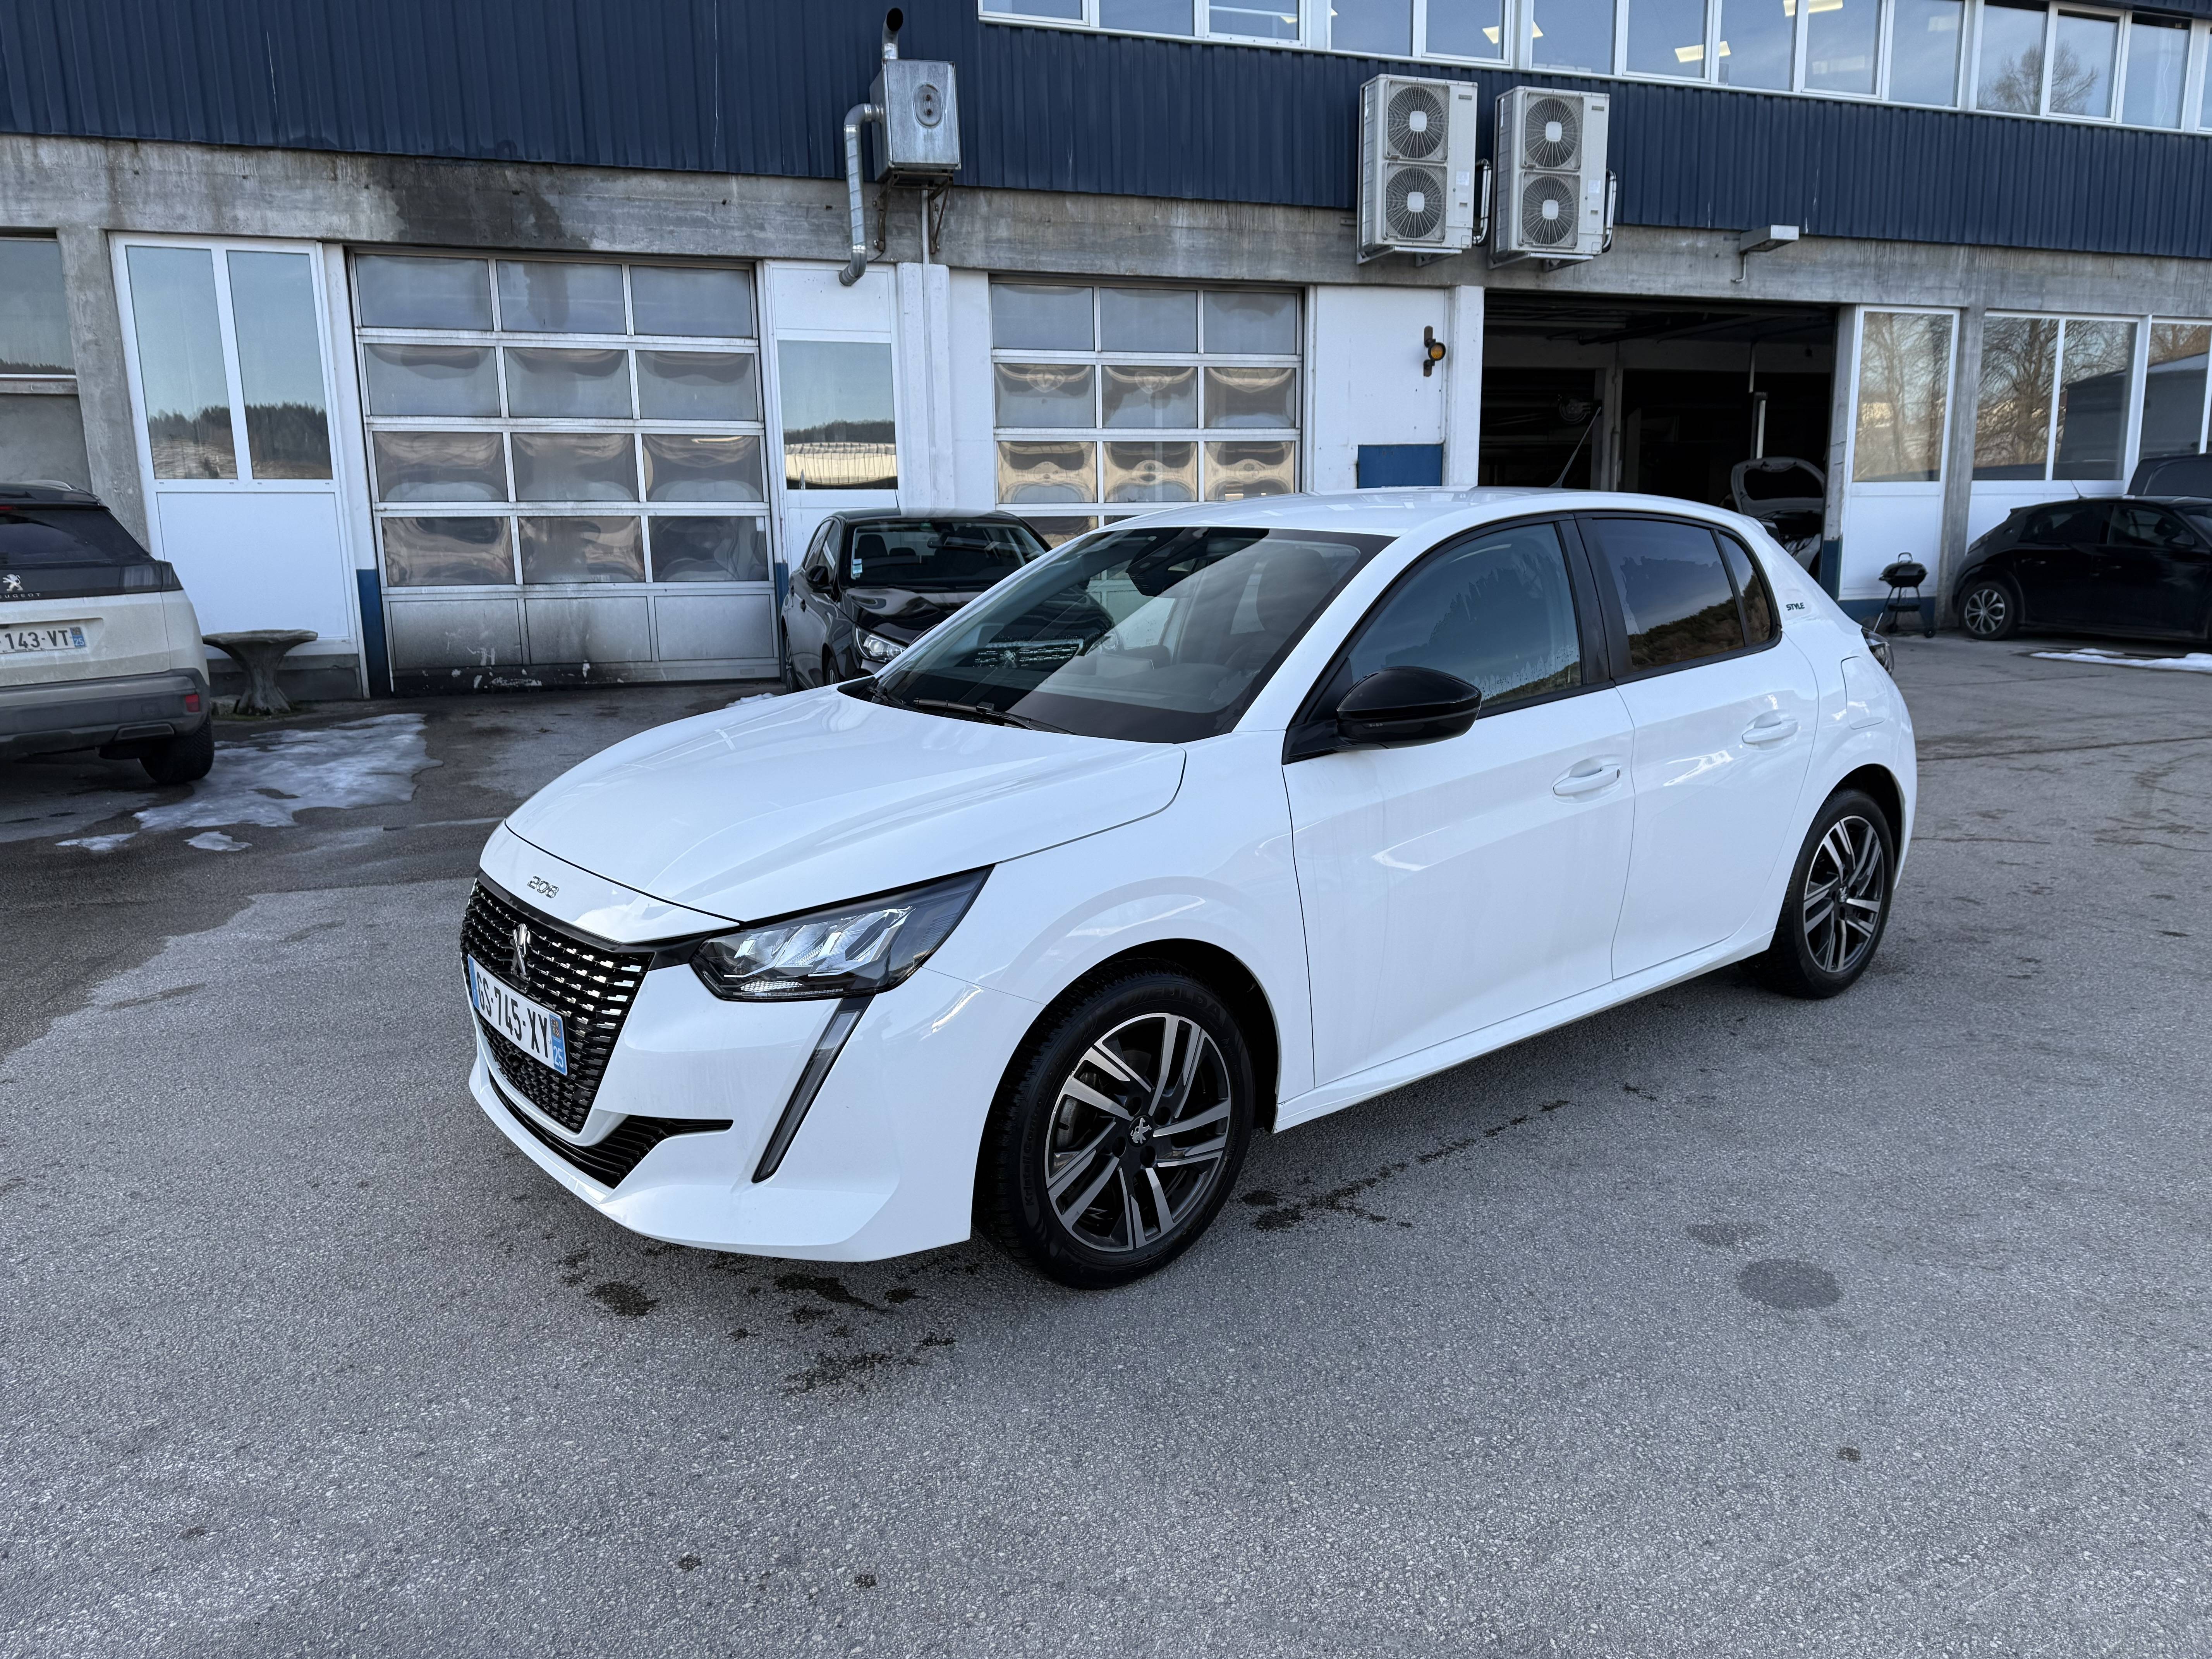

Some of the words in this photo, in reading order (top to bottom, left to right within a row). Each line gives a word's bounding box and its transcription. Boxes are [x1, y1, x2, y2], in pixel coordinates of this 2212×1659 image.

[1786, 602, 1805, 611] STYLE
[0, 630, 68, 649] 143-VT
[527, 876, 559, 898] 208
[477, 971, 548, 1058] GS-745-XY
[553, 1046, 563, 1068] 25
